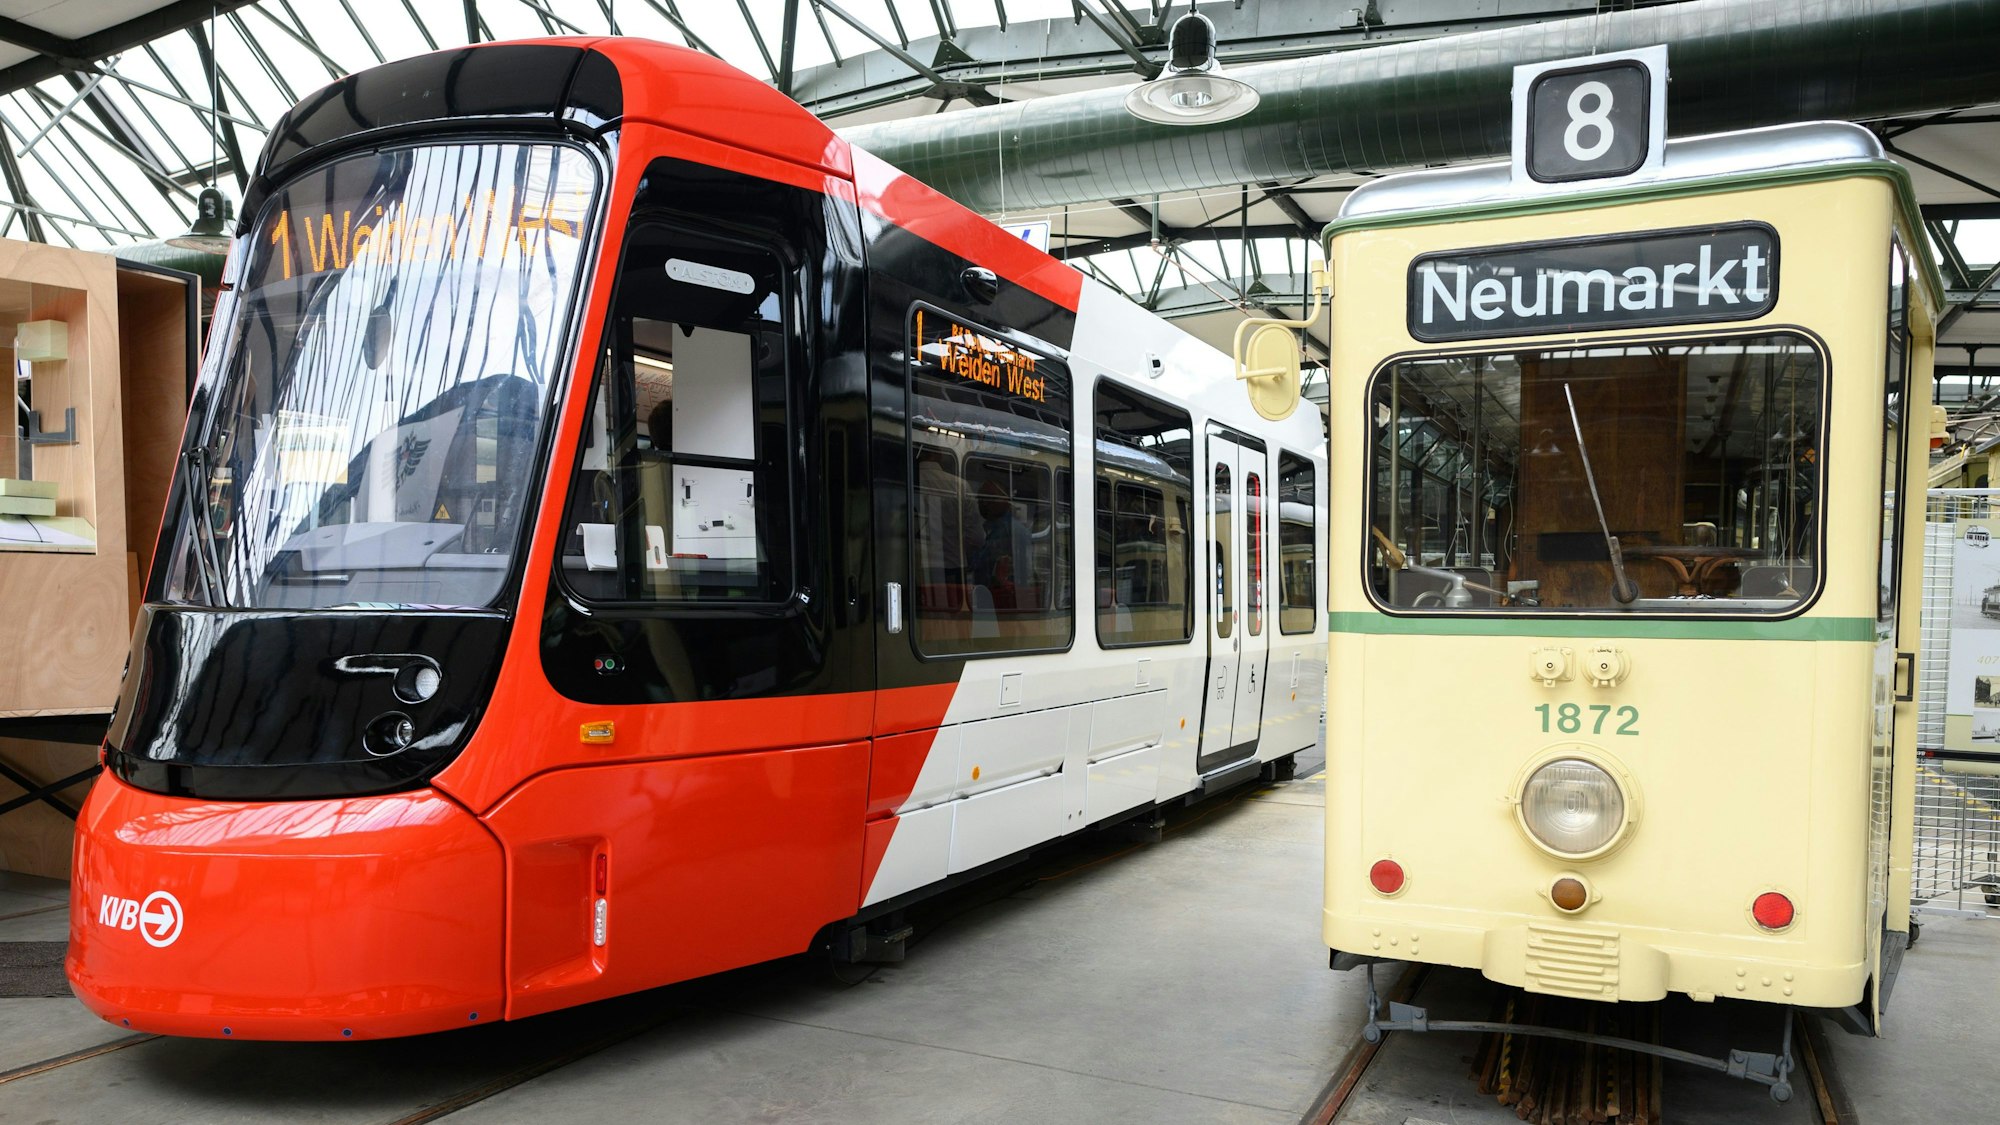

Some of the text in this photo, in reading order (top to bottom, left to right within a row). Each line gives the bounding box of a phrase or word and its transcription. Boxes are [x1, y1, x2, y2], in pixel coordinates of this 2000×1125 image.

[1563, 81, 1615, 161] 8
[272, 210, 291, 280] 1
[304, 202, 457, 272] Weiden
[1422, 244, 1766, 324] Neumarkt
[939, 338, 1000, 388] Weiden
[1007, 363, 1045, 403] West
[1535, 703, 1639, 736] 1872
[99, 894, 140, 931] KVB
